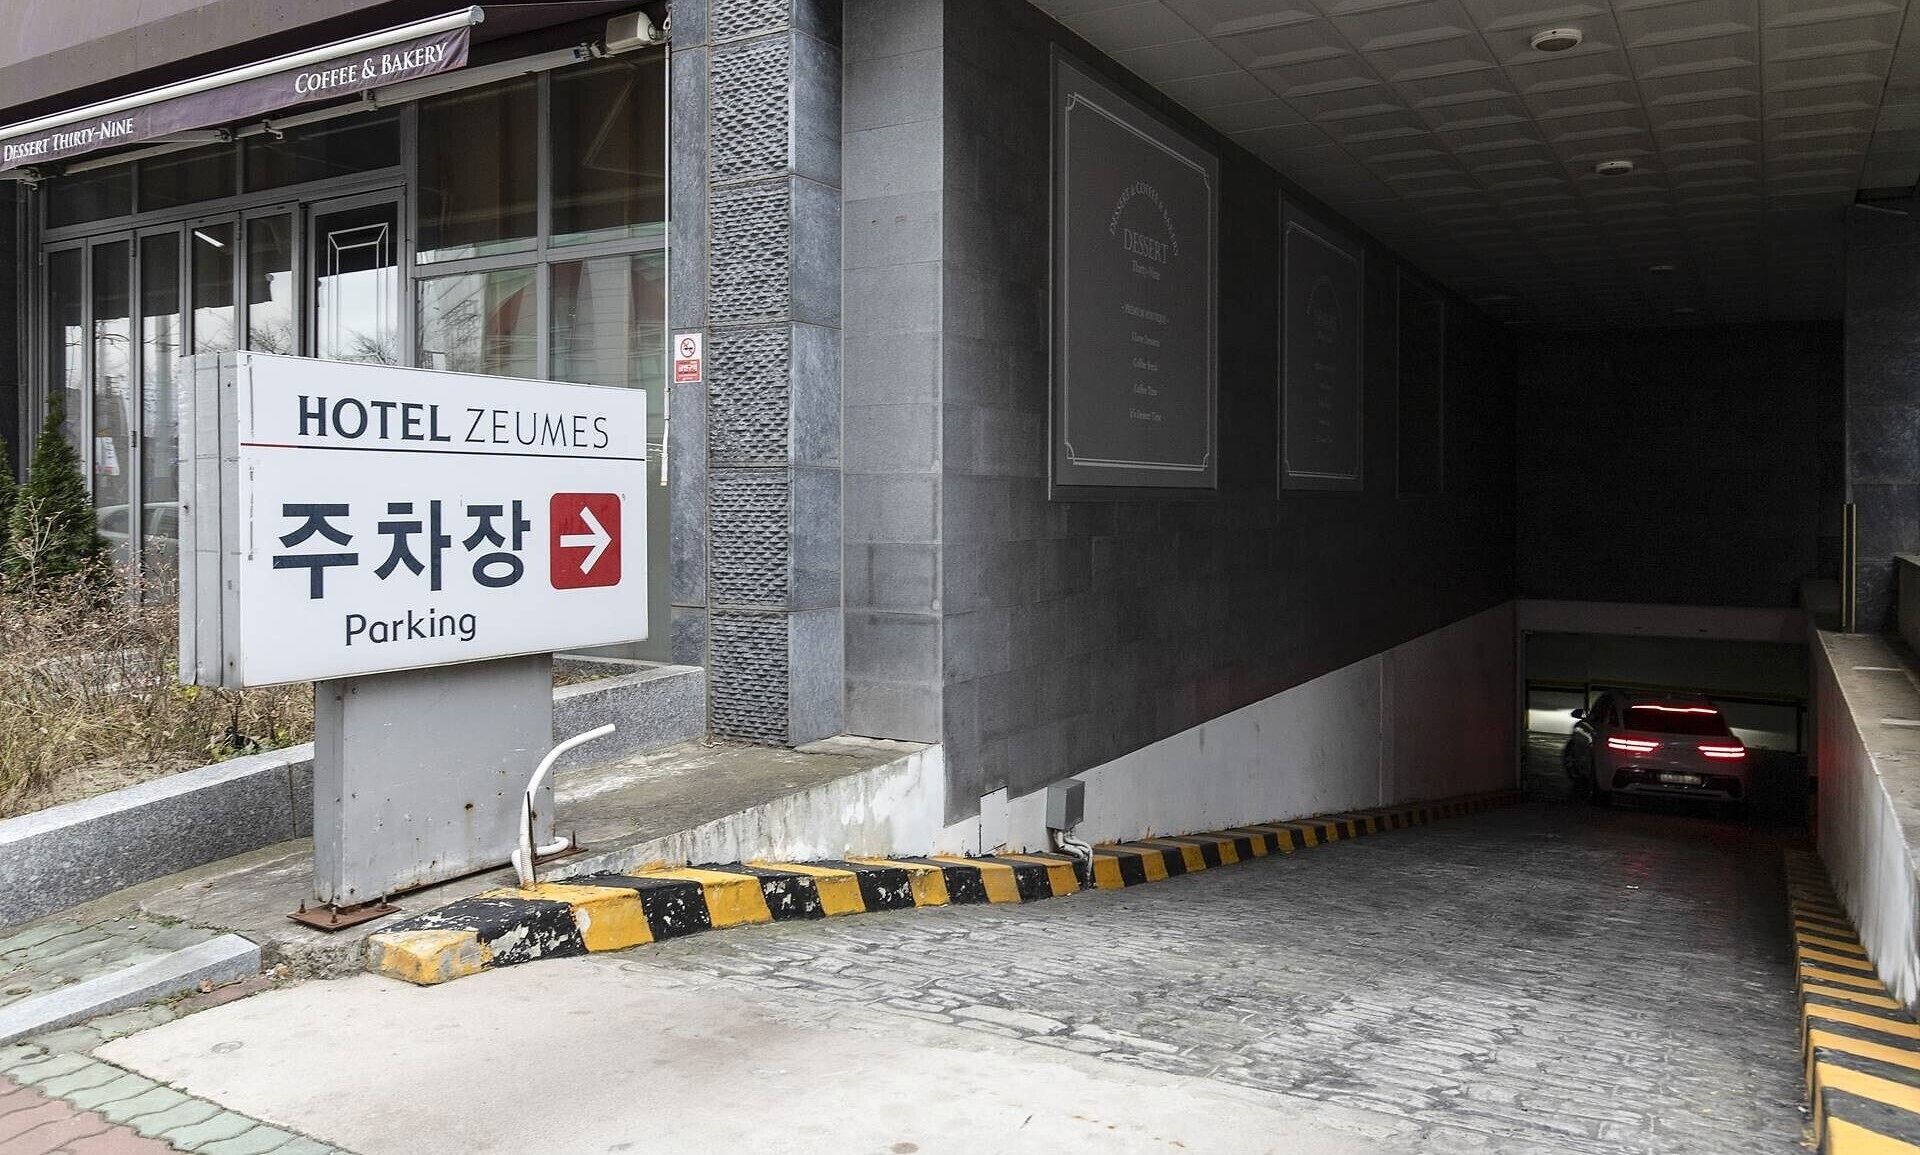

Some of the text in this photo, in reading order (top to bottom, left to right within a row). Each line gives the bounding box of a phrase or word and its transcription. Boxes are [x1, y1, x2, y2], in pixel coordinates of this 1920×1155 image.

[295, 42, 449, 94] COFFEE & BAKERY
[3, 118, 134, 162] DESSERT THIRTY-NINE
[1123, 228, 1168, 264] DESSERT
[297, 395, 609, 449] HOTEL ZEUMES
[272, 499, 531, 600] 주차장
[345, 608, 477, 646] Parking
